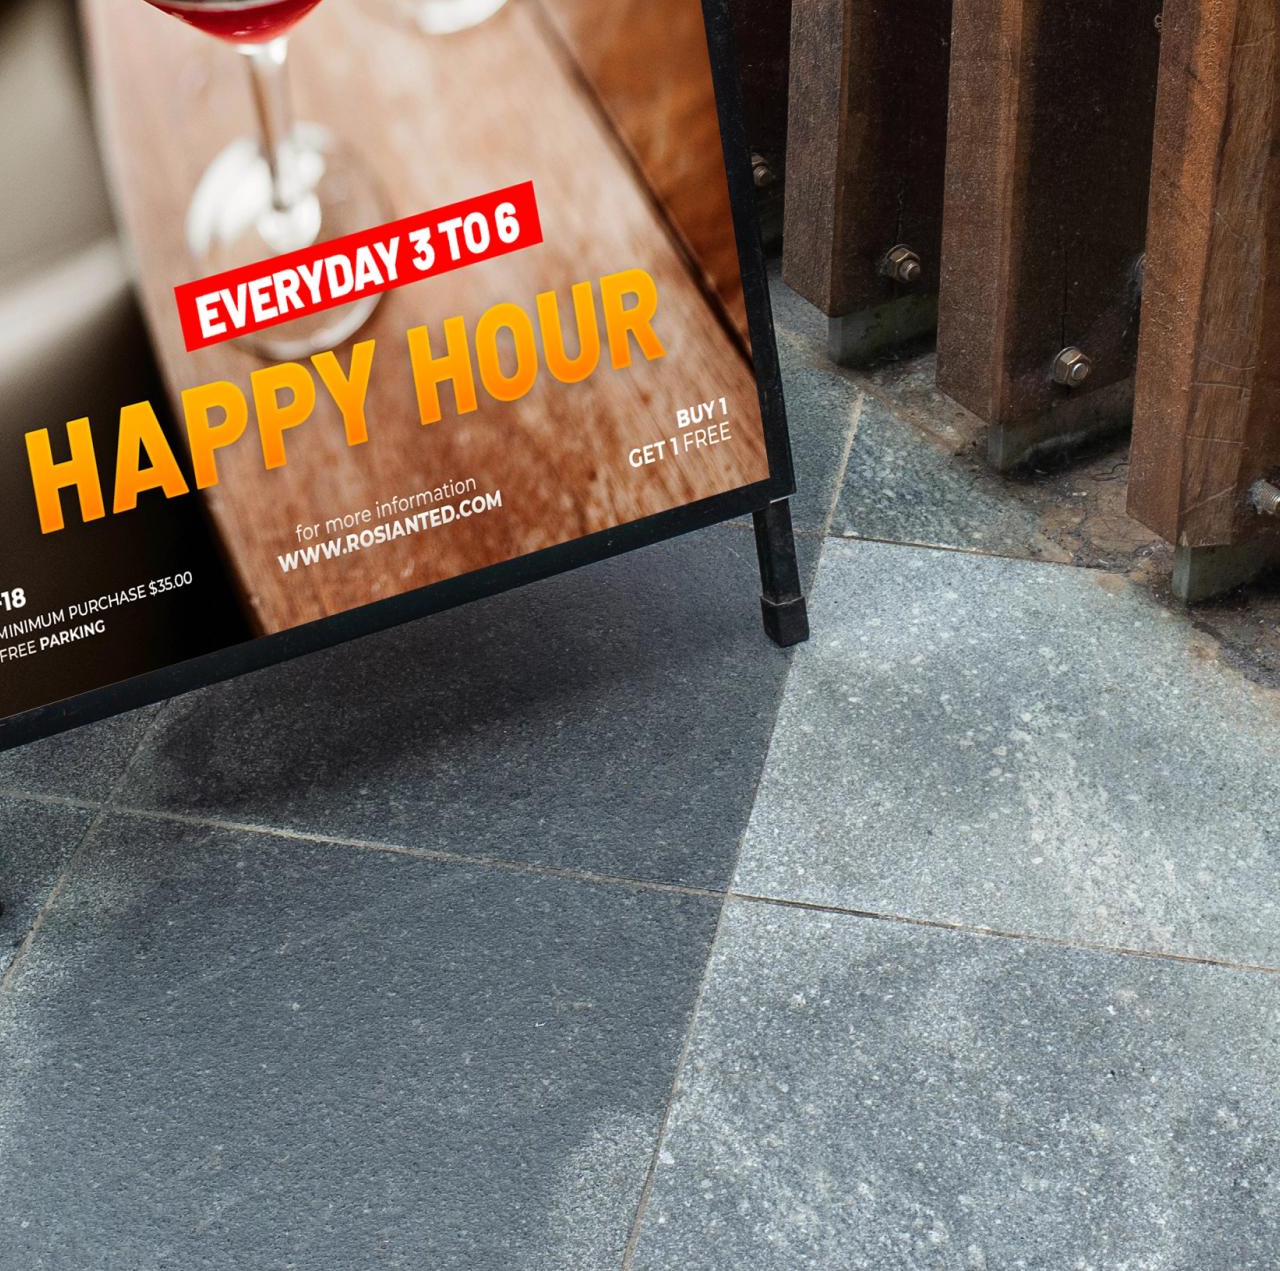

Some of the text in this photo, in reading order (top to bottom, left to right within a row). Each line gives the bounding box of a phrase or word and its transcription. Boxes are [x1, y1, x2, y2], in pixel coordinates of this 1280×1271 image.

[195, 202, 520, 339] EVERYDAY 3 TO 6
[25, 268, 666, 535] HAPPY HOUR
[676, 397, 728, 428] BUY 1
[628, 421, 732, 468] GET 1 FREE
[277, 490, 503, 573] WWW.ROSIANTED.COM
[295, 477, 477, 542] for more information
[69, 584, 147, 620] PURCHASE
[148, 571, 193, 597] $35.00
[0, 619, 106, 663] FREE PARKING
